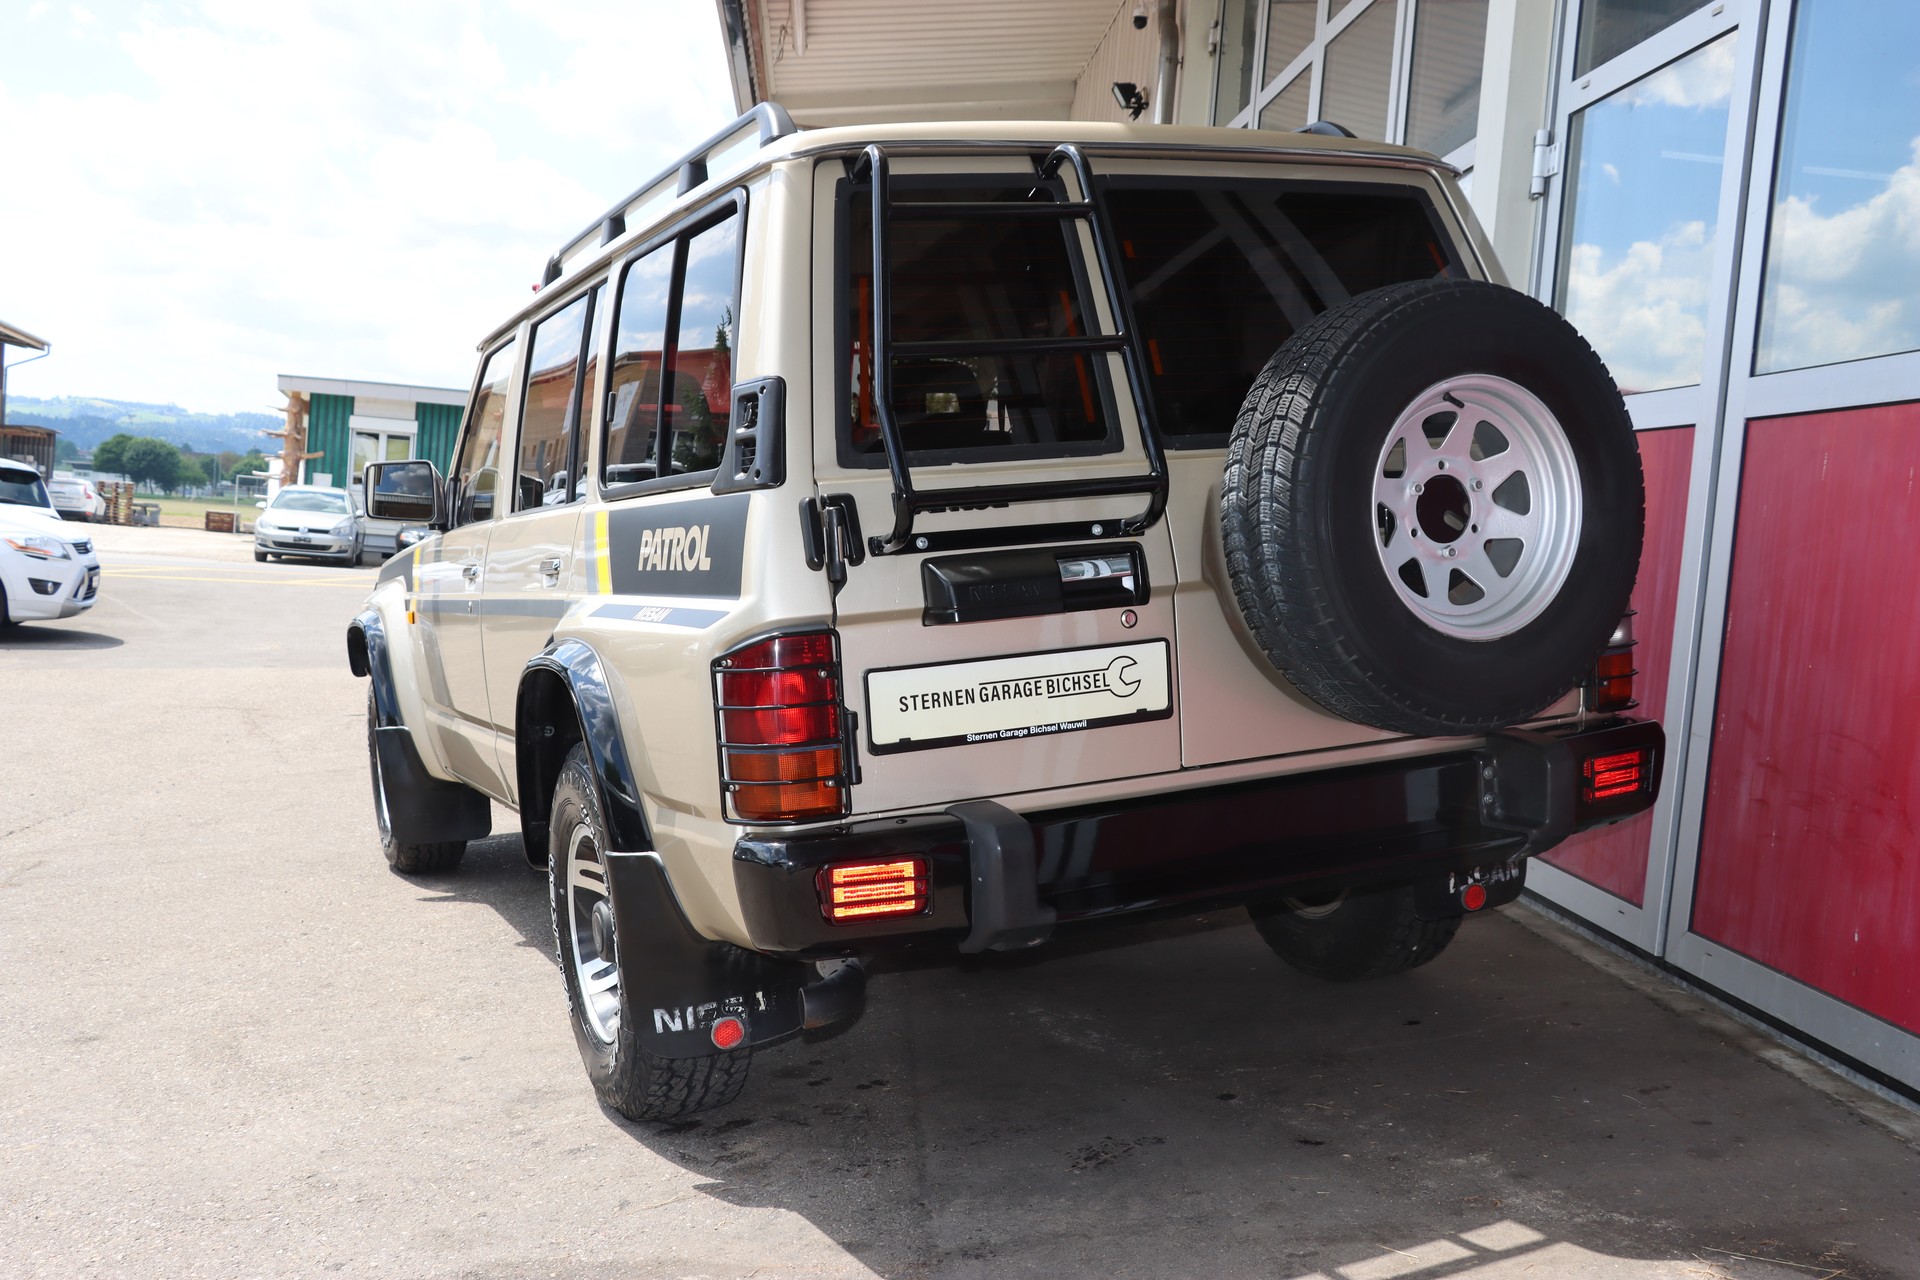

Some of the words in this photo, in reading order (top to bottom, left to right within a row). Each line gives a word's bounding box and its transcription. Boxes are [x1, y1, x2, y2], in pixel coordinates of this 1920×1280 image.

[638, 524, 711, 572] PATROL
[899, 687, 976, 713] STERNEN
[979, 679, 1043, 704] GARAGE
[1046, 672, 1111, 695] BICHSEL
[966, 730, 998, 742] Sternen
[999, 727, 1028, 739] Garage
[1030, 723, 1058, 734] Bichsel
[1060, 720, 1087, 731] Wauwil
